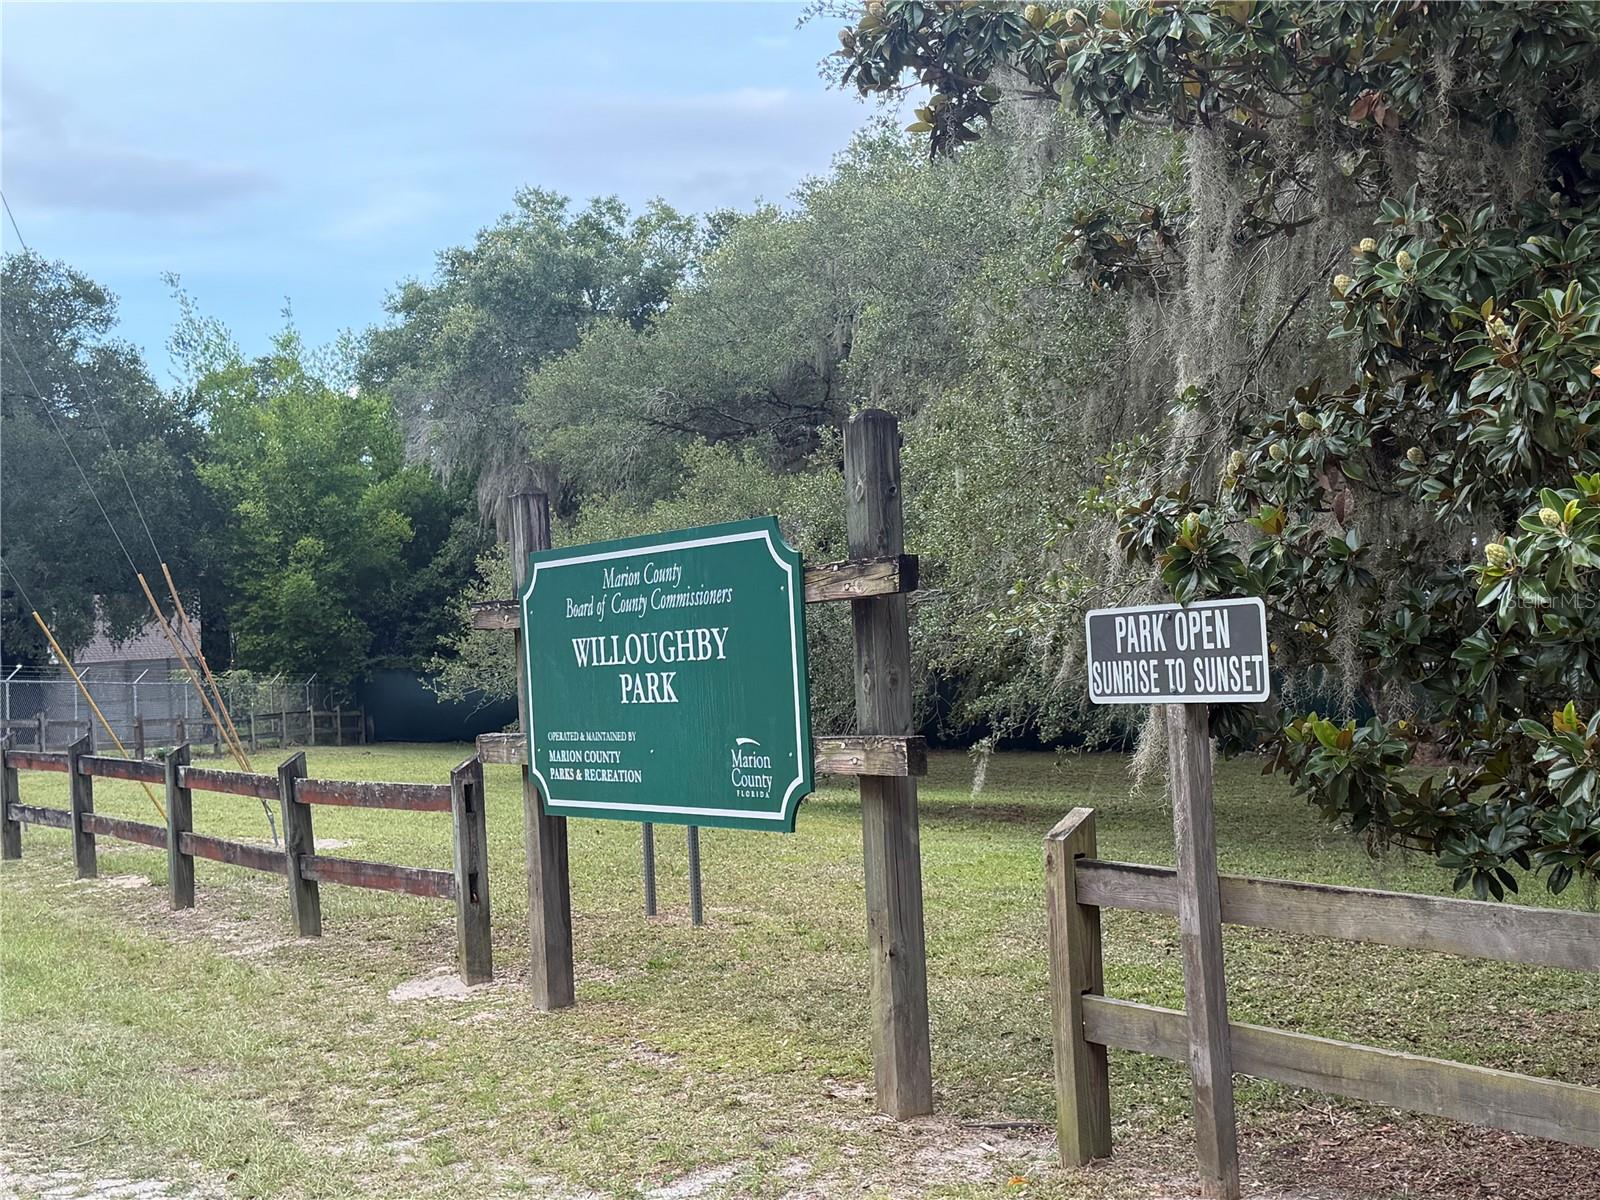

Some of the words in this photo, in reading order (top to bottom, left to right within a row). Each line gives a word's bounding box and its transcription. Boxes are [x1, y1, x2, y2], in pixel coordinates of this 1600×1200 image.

[603, 568, 639, 589] Marion
[644, 562, 681, 588] County
[566, 597, 594, 618] Board
[596, 595, 607, 622] of
[611, 592, 647, 618] County
[651, 586, 732, 611] Commissioners
[1115, 613, 1166, 653] PARK
[1175, 609, 1230, 651] OPEN
[572, 627, 729, 667] WILLOUGHBY
[1093, 659, 1160, 695] SUNRISE
[1165, 658, 1186, 693] TO
[1193, 655, 1262, 693] SUNSET
[620, 672, 678, 704] PARK
[548, 732, 580, 742] OPERATED
[580, 733, 585, 741] &
[586, 732, 627, 741] MAINTAINED
[628, 731, 636, 741] BY
[549, 751, 582, 763] MARION
[584, 751, 621, 763] COUNTY
[732, 749, 771, 769] Marion
[550, 768, 574, 780] PARKS
[576, 769, 582, 781] &
[584, 769, 642, 783] RECREATION
[732, 769, 772, 792] County
[736, 790, 770, 798] FLORIDA
